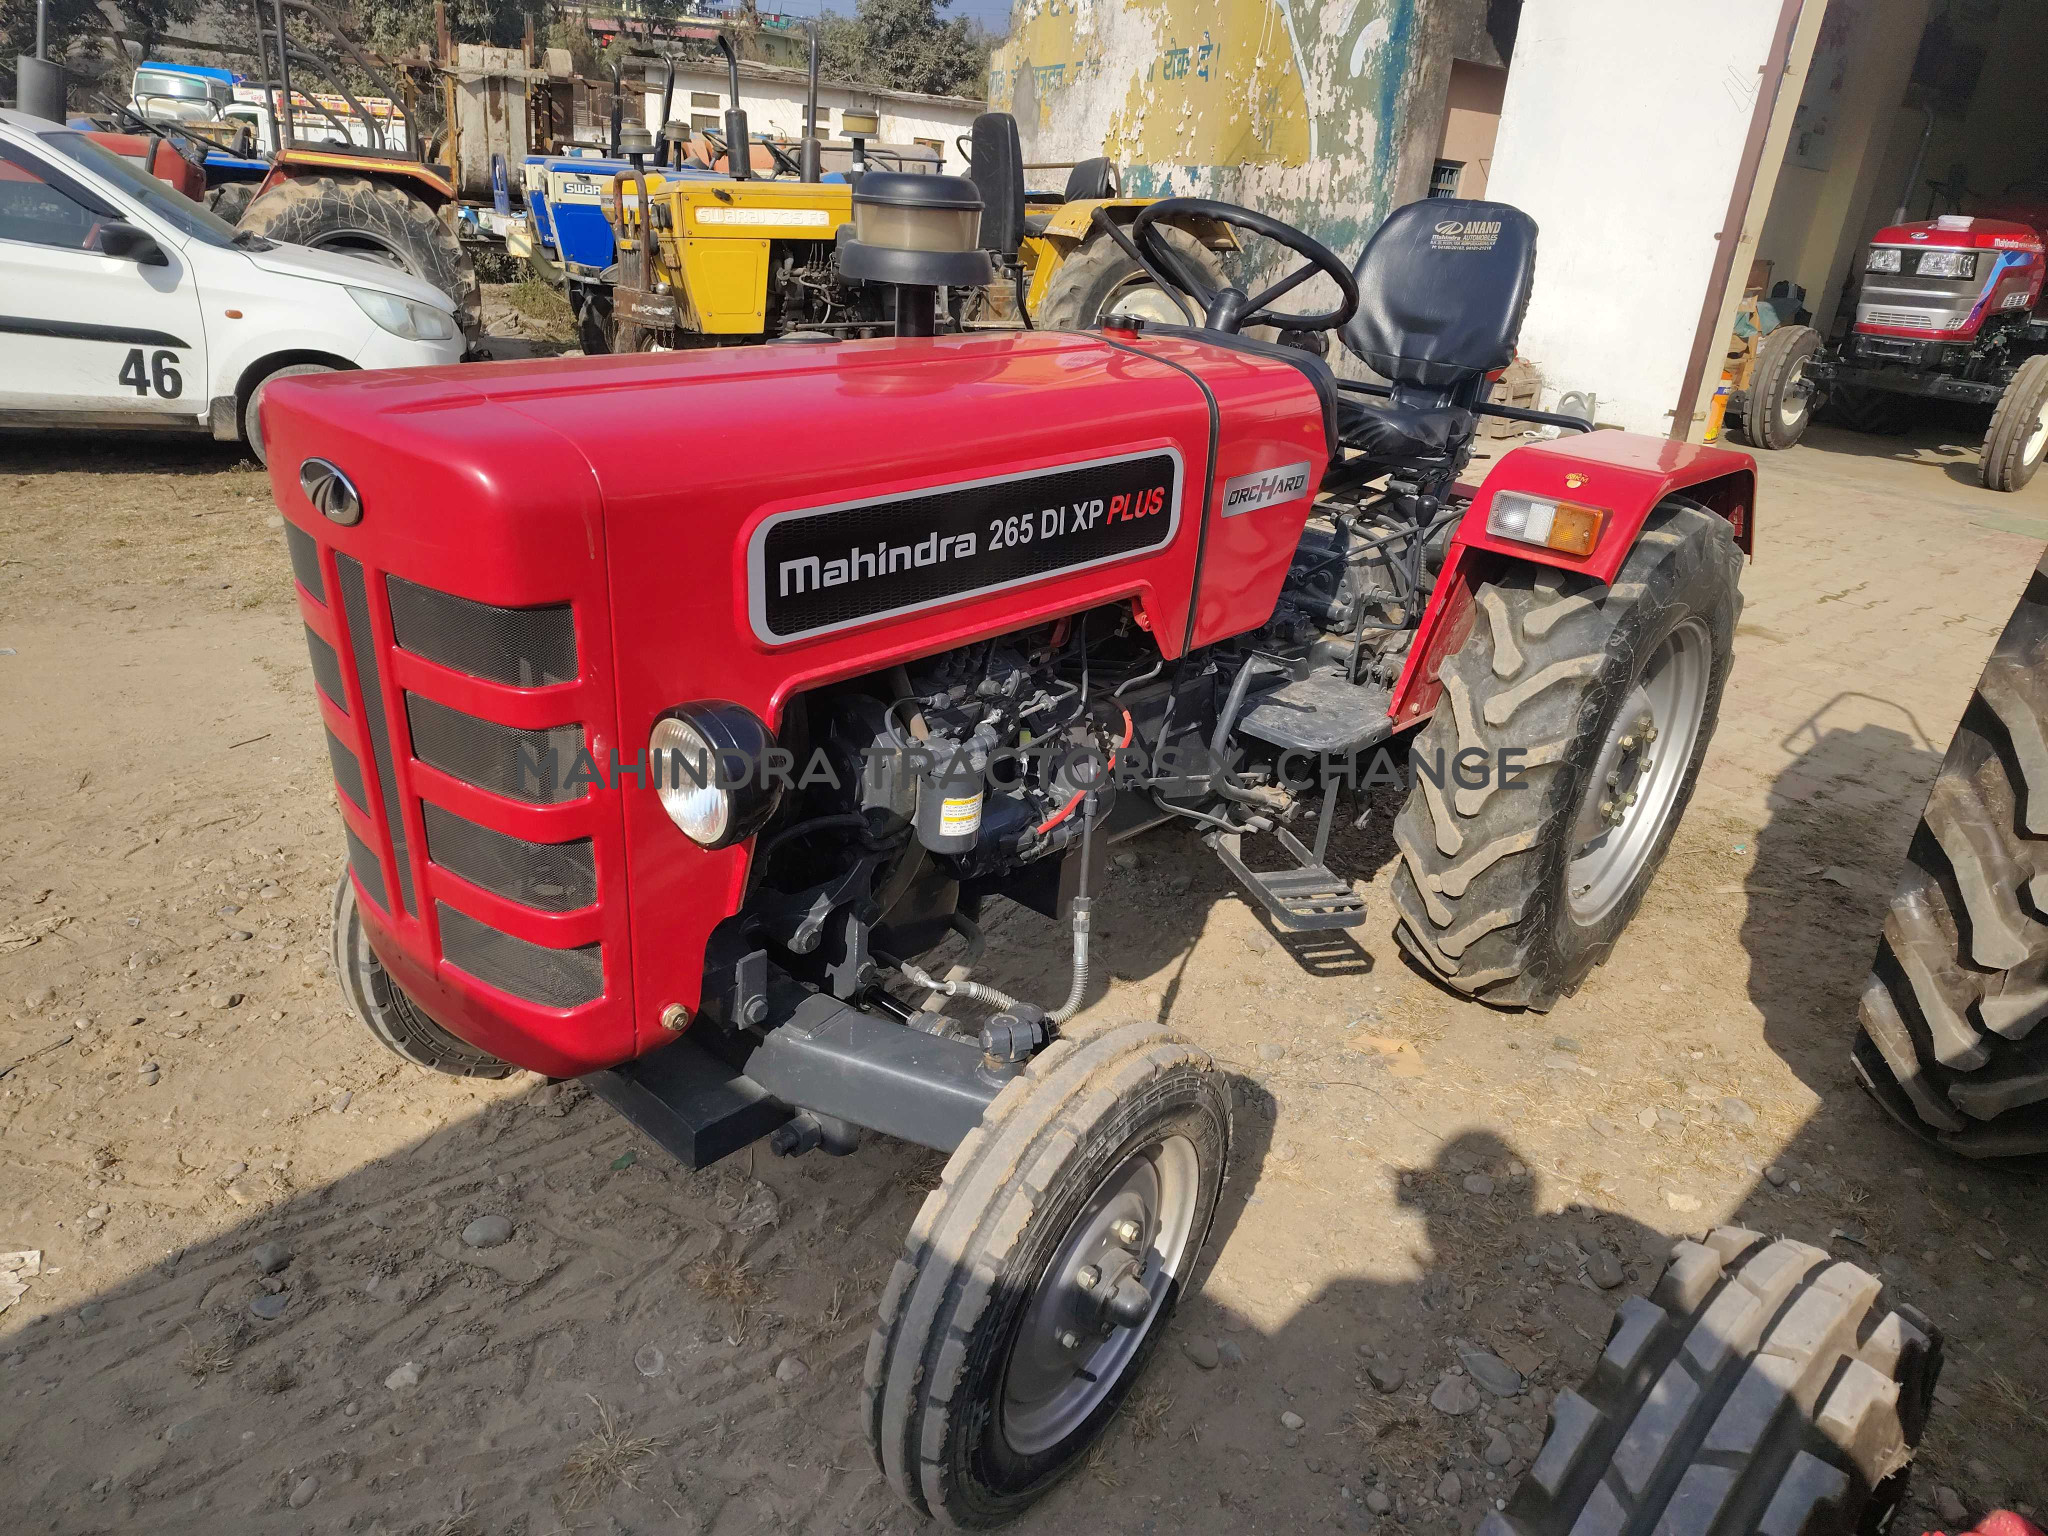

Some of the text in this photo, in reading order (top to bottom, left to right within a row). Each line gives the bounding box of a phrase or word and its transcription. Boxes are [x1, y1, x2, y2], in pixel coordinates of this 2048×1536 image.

[1463, 221, 1501, 234] ANAND
[118, 348, 183, 400] 46
[779, 486, 1165, 598] Mahindra 265 DI XP PLUS
